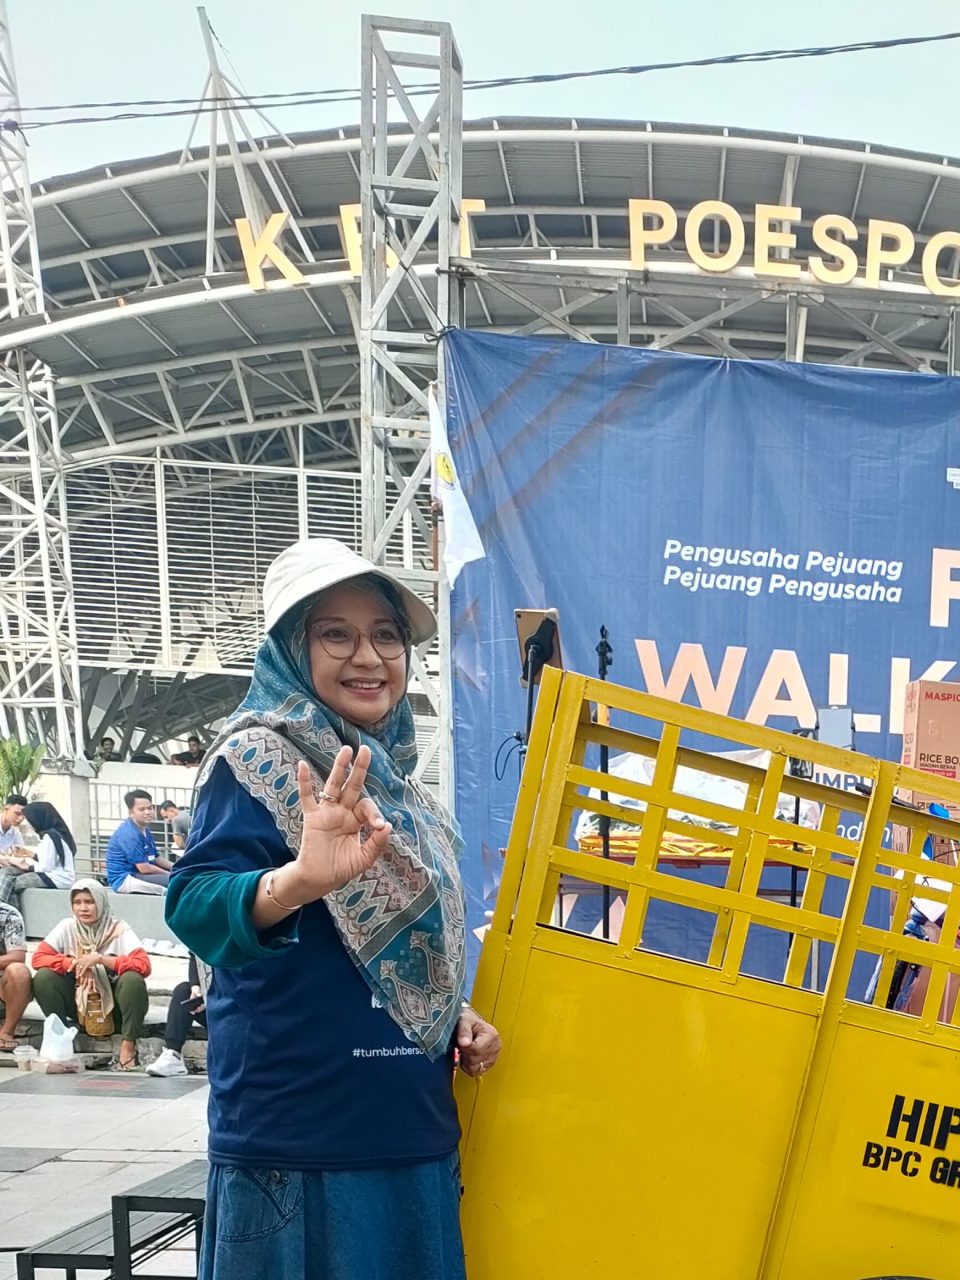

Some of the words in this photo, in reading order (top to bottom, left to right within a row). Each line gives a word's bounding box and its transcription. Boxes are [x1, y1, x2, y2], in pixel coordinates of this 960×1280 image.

[663, 539, 800, 570] Pengusaha
[804, 550, 904, 581] Pejuang
[663, 565, 763, 597] Pejuang
[768, 573, 903, 604] Pengusaha
[919, 753, 943, 764] RICE
[862, 1141, 922, 1178] BPC
